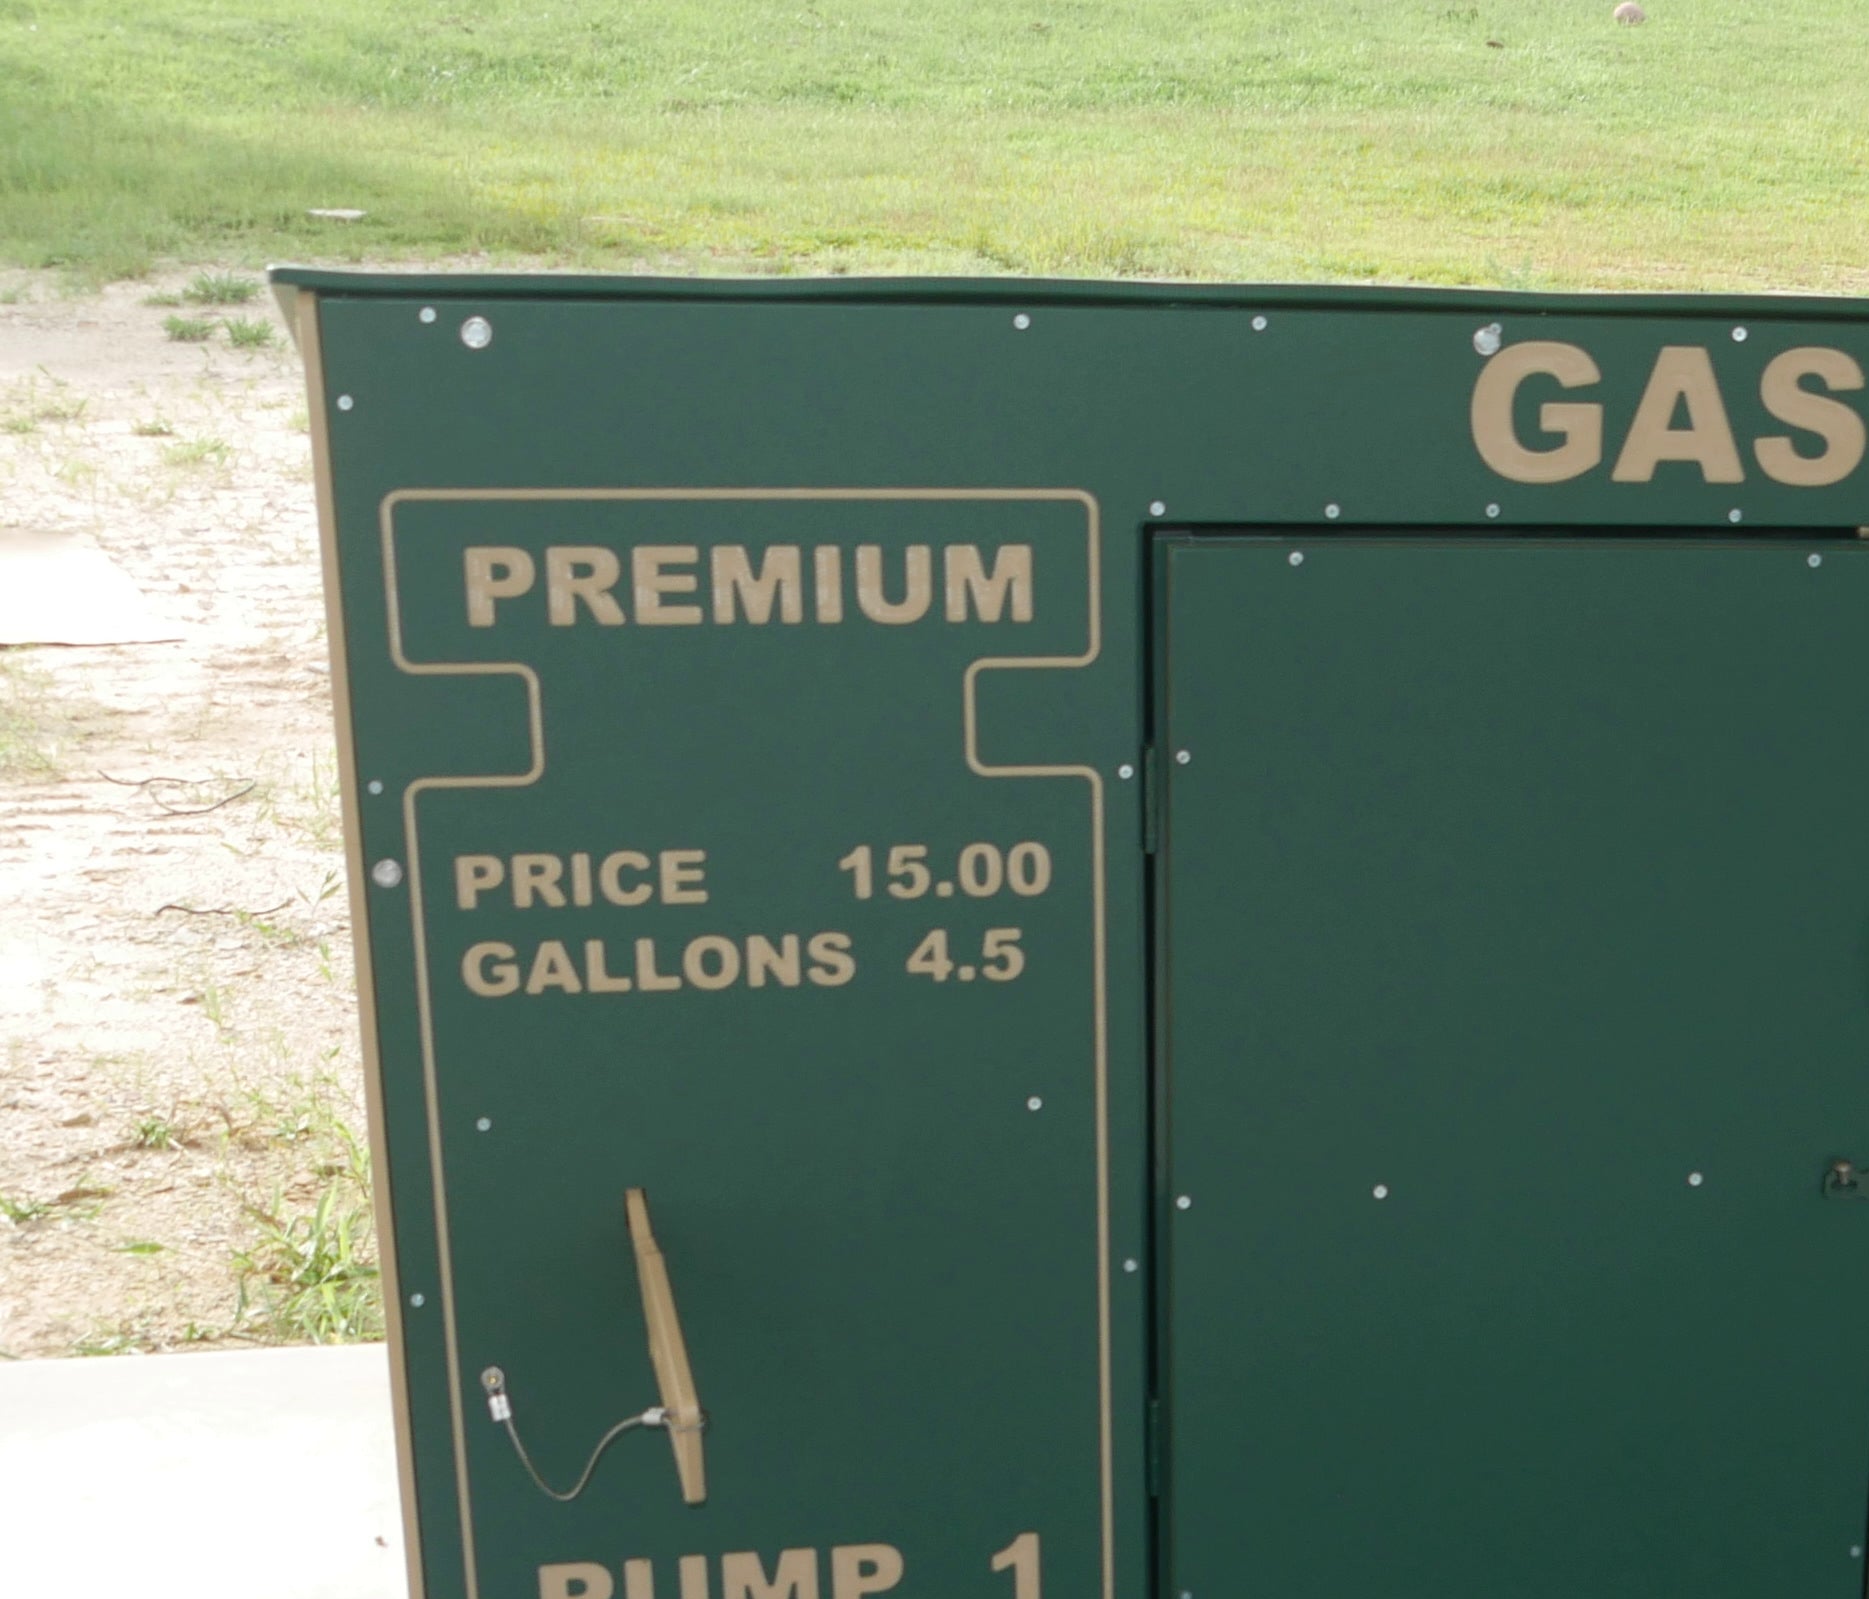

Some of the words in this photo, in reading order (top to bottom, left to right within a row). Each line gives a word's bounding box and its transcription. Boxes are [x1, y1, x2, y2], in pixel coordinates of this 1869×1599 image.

[465, 544, 1032, 626] PREMIUM
[456, 850, 707, 908] PRICE
[839, 842, 1051, 898] 15.00
[463, 932, 853, 996] GALLONS
[908, 928, 1023, 981] 4.5
